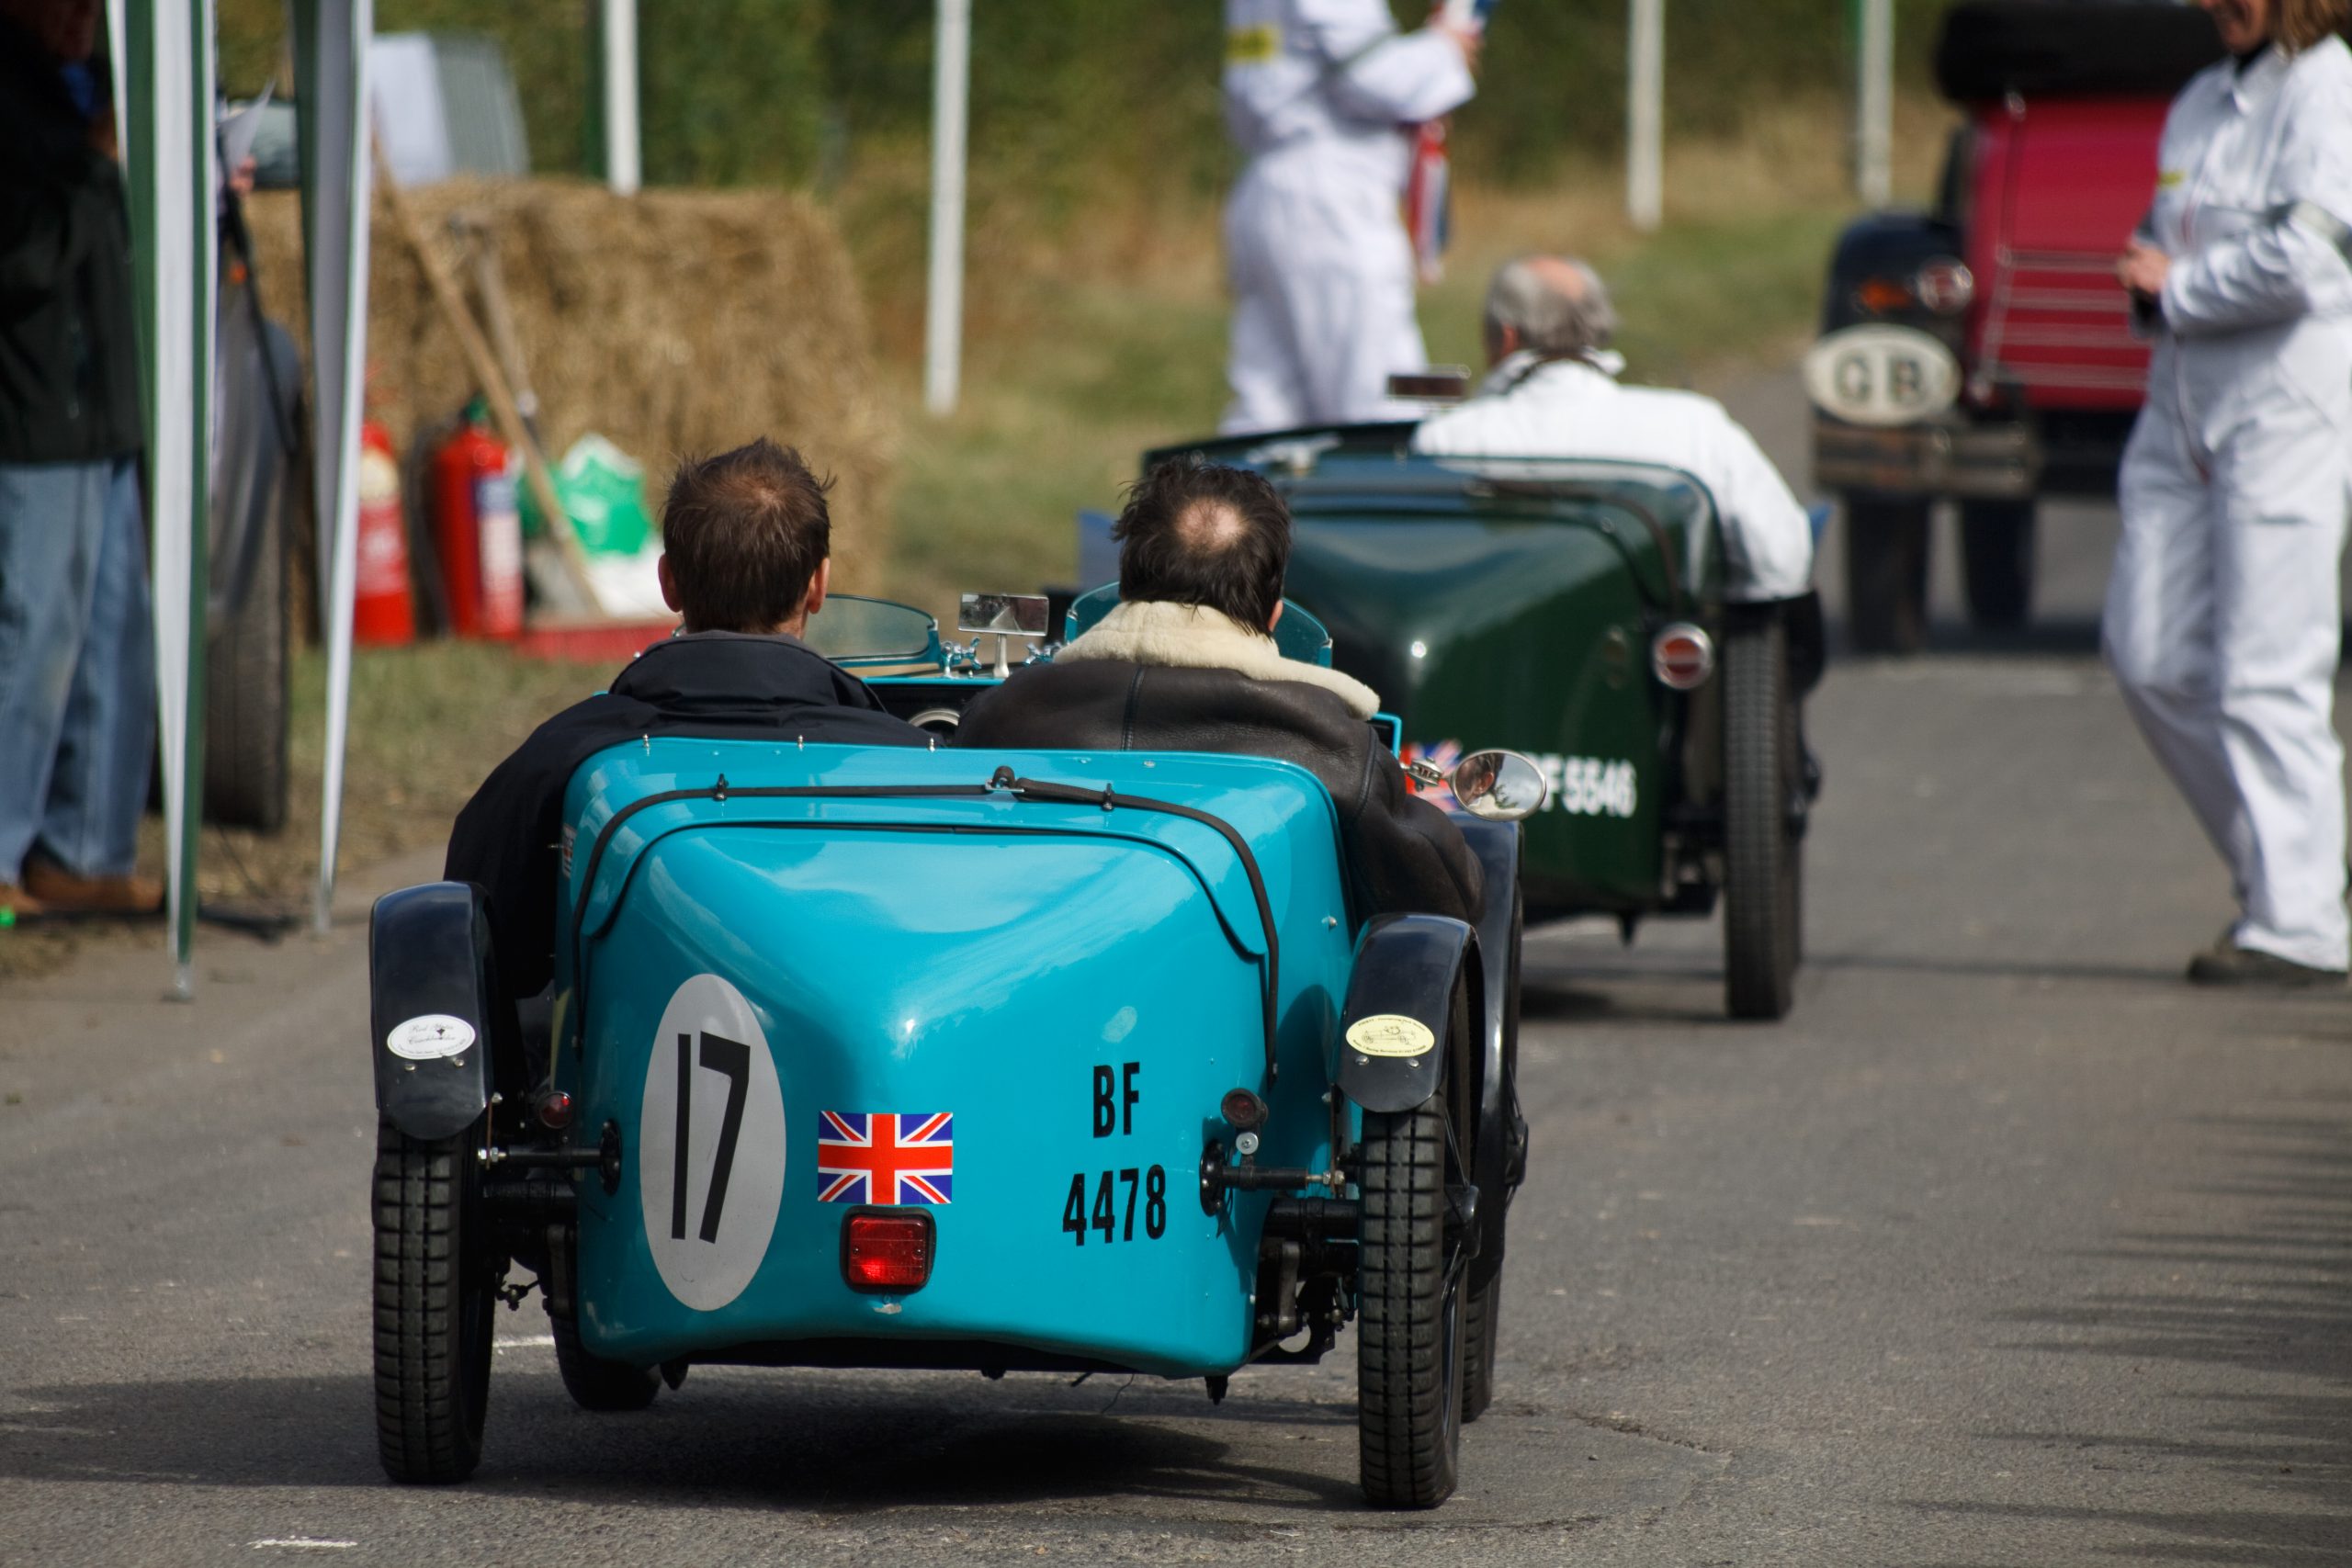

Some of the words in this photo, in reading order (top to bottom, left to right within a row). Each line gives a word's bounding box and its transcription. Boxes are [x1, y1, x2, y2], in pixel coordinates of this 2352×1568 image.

[1834, 349, 1926, 405] GB
[672, 1030, 751, 1244] 17
[1093, 1062, 1140, 1138] BF
[1063, 1164, 1166, 1247] 4478
